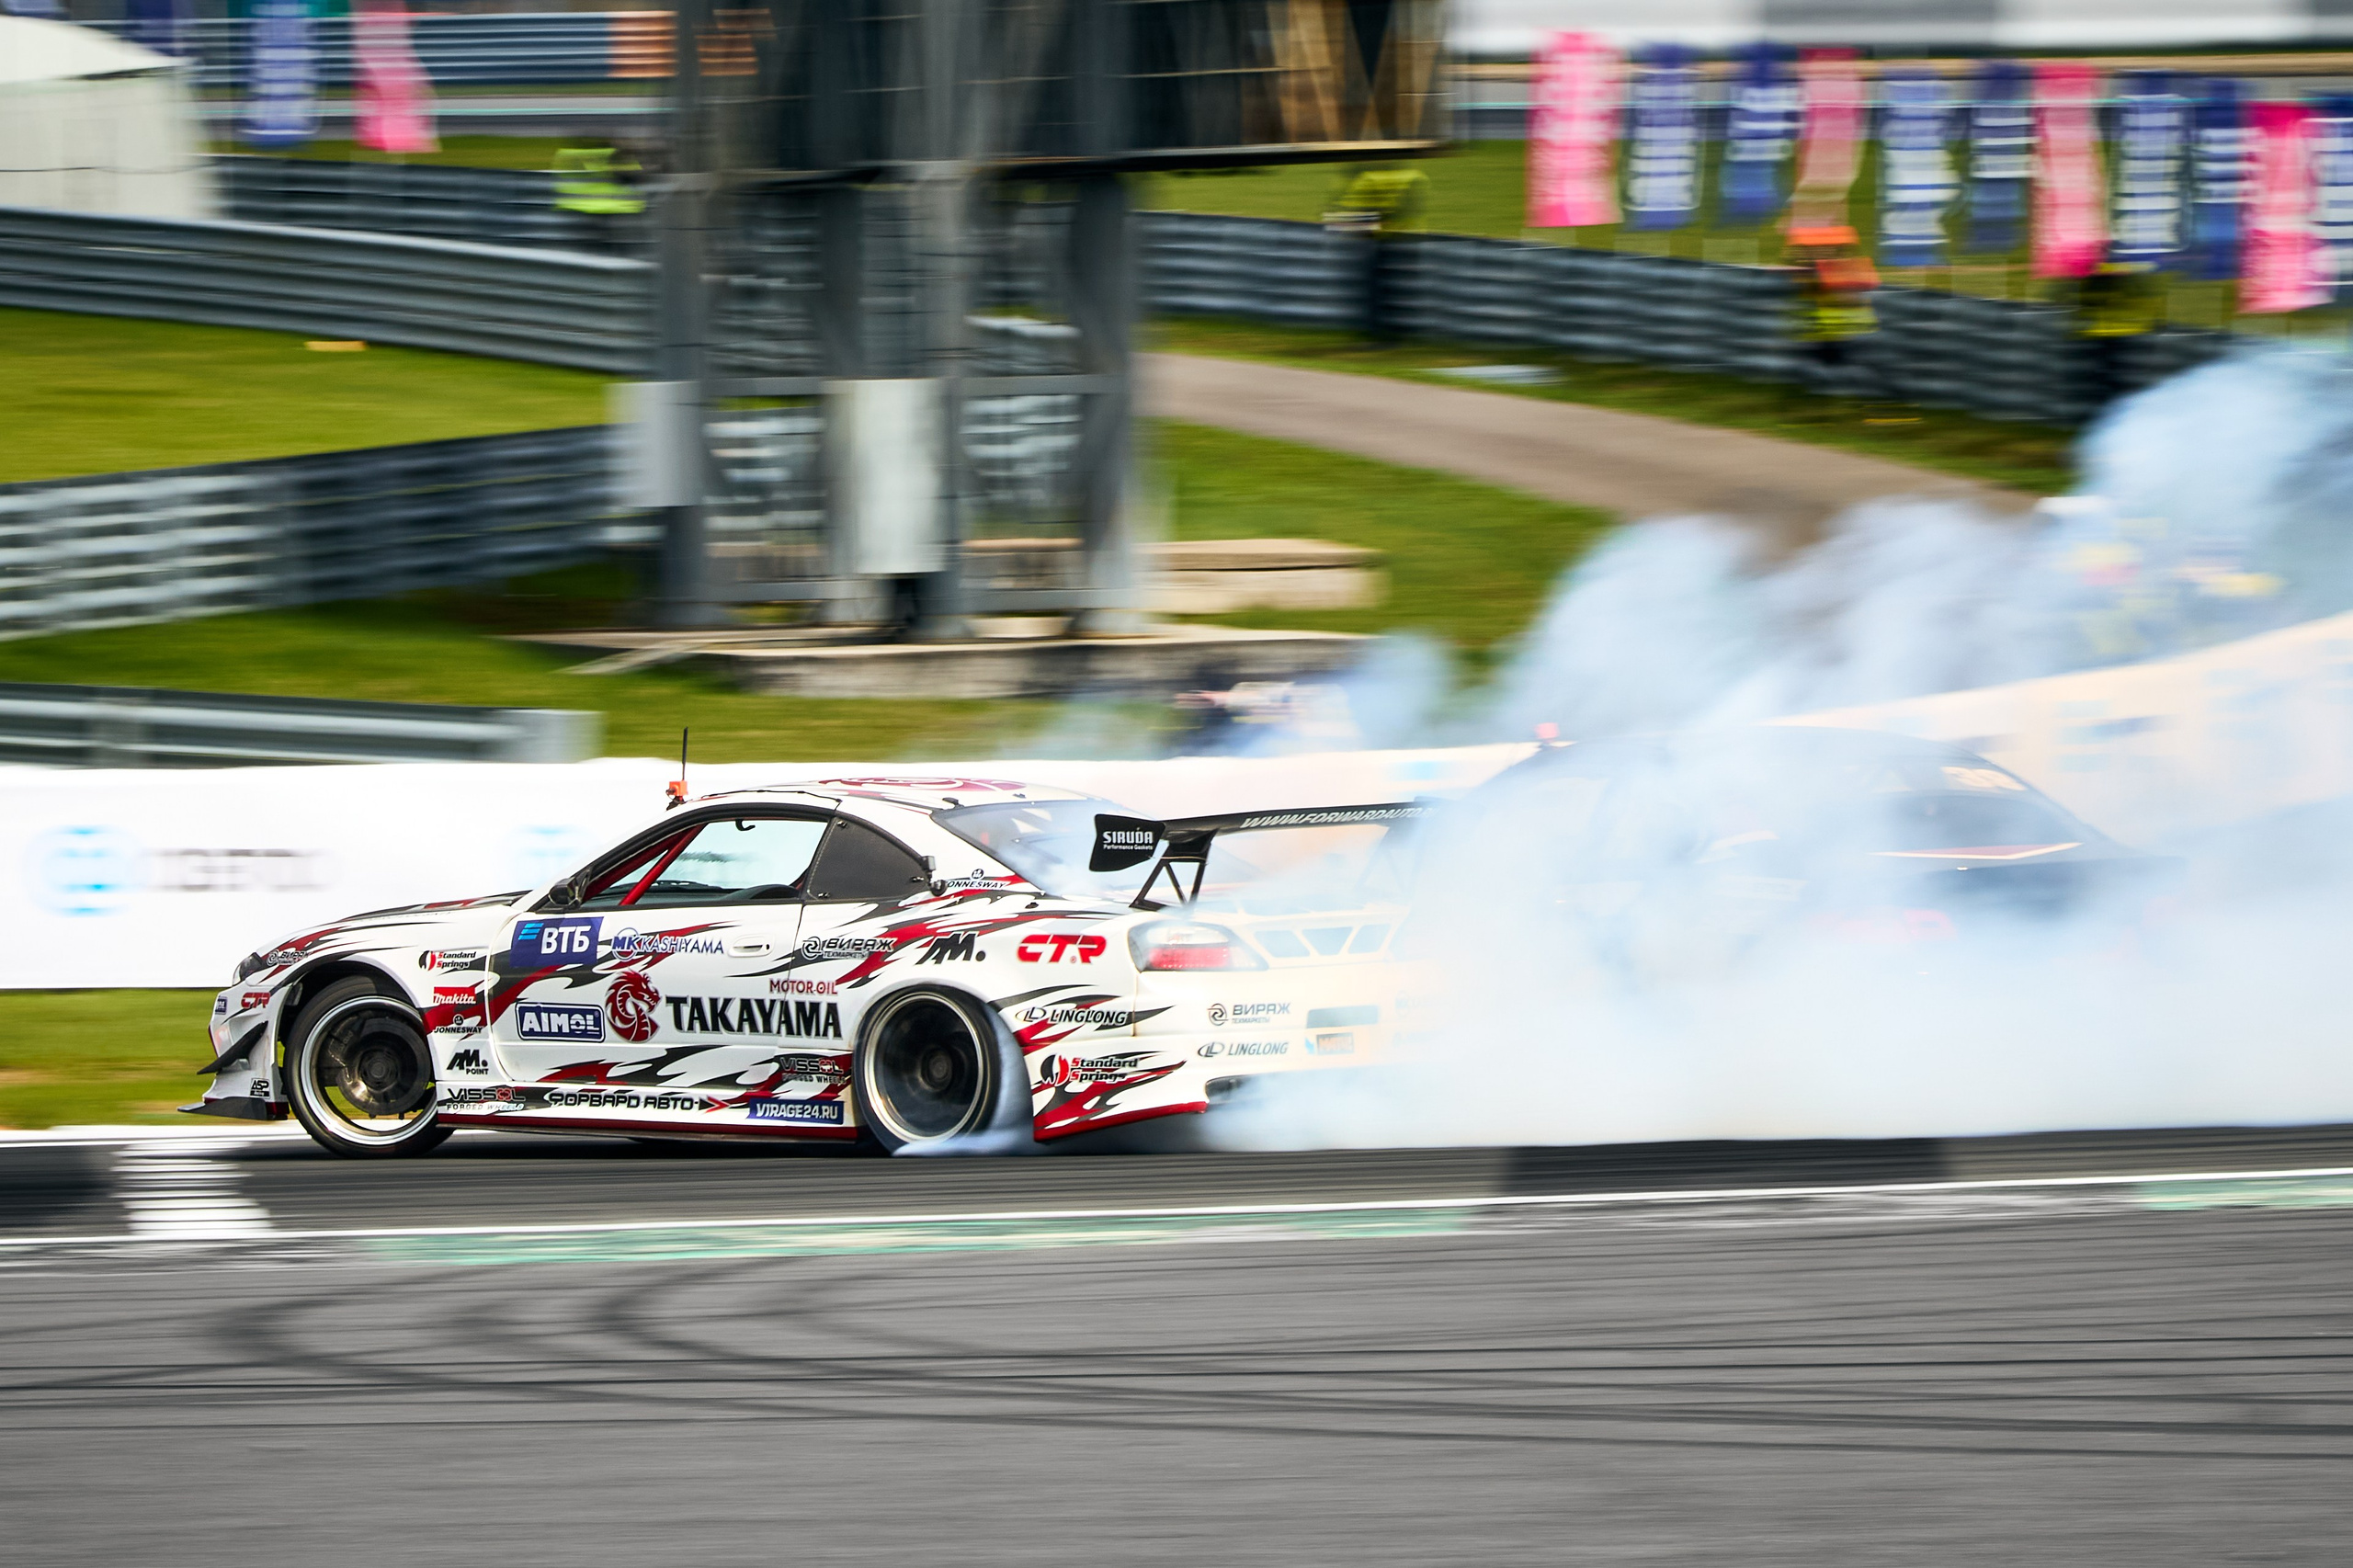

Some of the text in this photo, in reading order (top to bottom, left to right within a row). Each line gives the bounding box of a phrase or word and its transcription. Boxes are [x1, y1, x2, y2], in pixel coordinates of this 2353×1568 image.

[1102, 828, 1154, 844] SIRUDA
[947, 881, 1006, 889] ONNESWAY
[540, 925, 592, 955] ВТБ
[641, 935, 725, 955] KASHIYAMA
[824, 937, 892, 951] ВИРАЖ
[1017, 935, 1107, 963] CTR
[437, 960, 469, 969] Springs
[769, 978, 838, 995] MOTOR OIL
[241, 993, 270, 1008] CTR
[665, 994, 844, 1040] TAKAYAMA
[1049, 1009, 1128, 1024] LINGLONG
[1233, 1003, 1291, 1016] ВИРАЖ
[522, 1012, 600, 1035] AIMOL
[1228, 1041, 1290, 1056] LINGLONG
[1071, 1057, 1138, 1068] Standard
[1070, 1070, 1127, 1082] Springs
[251, 1080, 269, 1090] ASP
[447, 1087, 527, 1101] VISSOL
[549, 1092, 640, 1108] ФОРВАРД
[756, 1103, 839, 1119] VIRAGE24.RU
